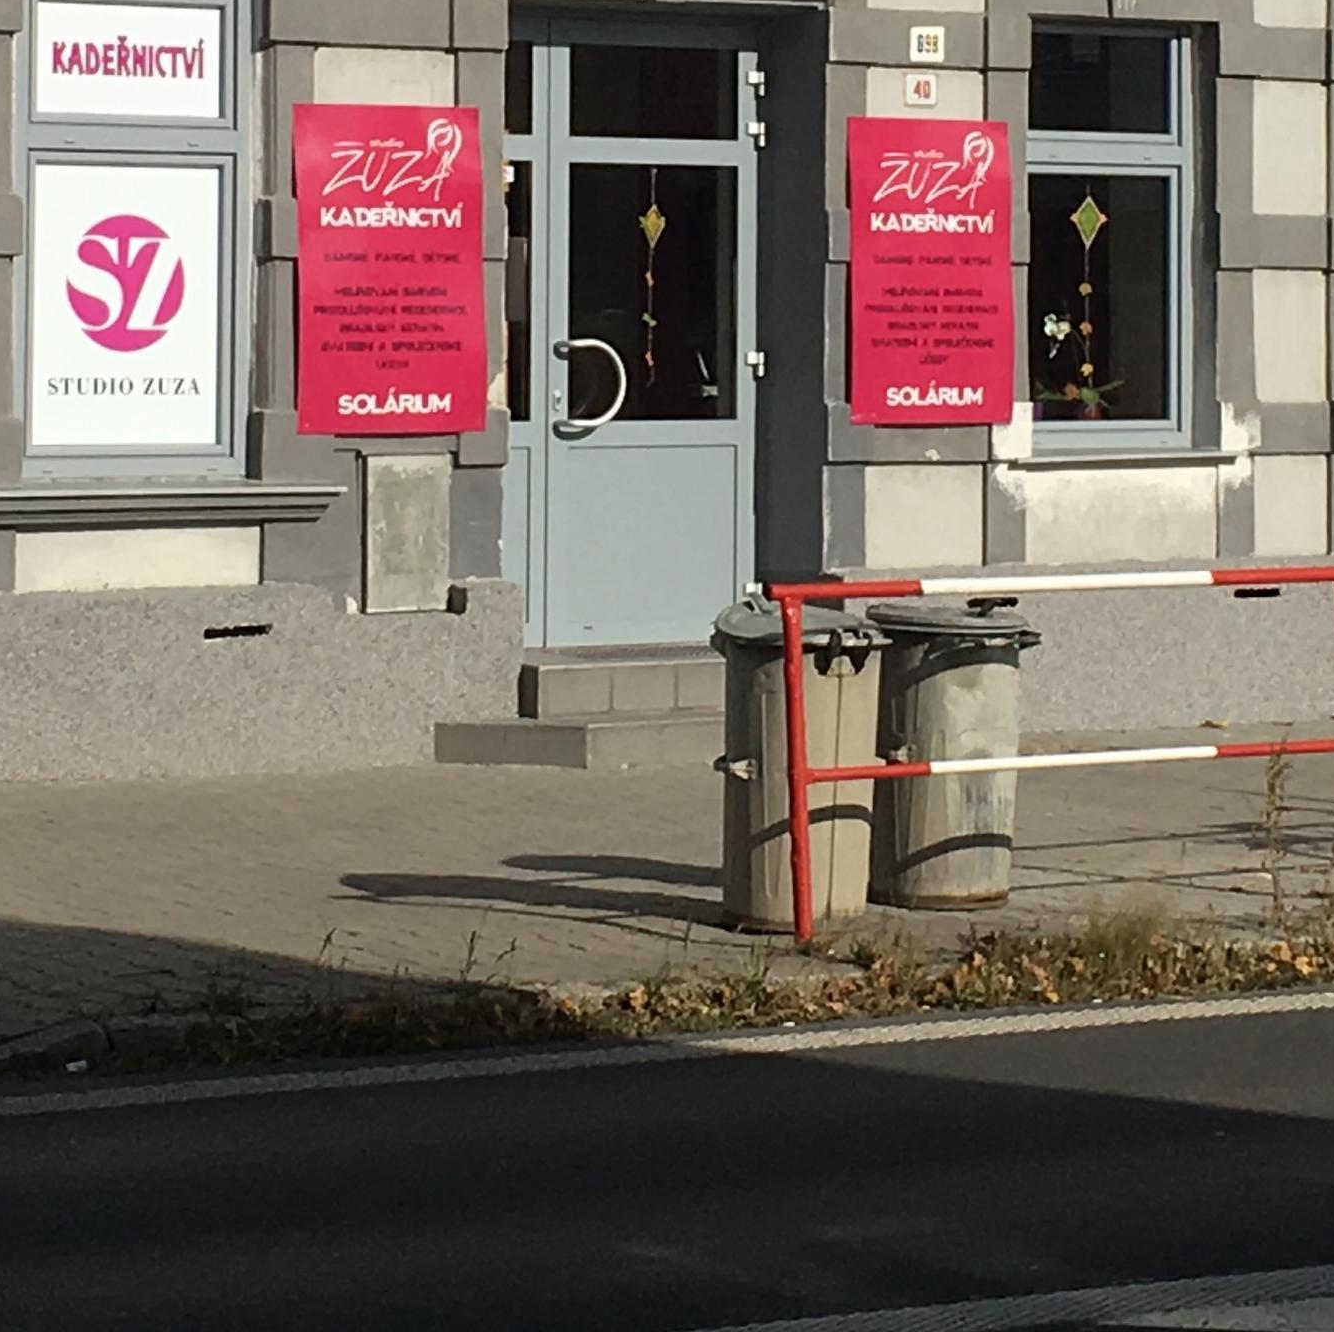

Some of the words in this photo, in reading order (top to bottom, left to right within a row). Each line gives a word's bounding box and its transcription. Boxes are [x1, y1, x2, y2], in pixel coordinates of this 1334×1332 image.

[52, 35, 204, 79] KADEŘNICTVÍ
[913, 80, 931, 99] 40
[320, 201, 464, 228] KADEŘNICTVÍ
[870, 207, 995, 234] KADEŘNICTVÍ
[47, 377, 134, 396] STUDIO
[143, 377, 201, 396] ZUZA
[886, 380, 984, 407] SOLÁRIUM
[338, 387, 452, 415] SOLÁRIUM
